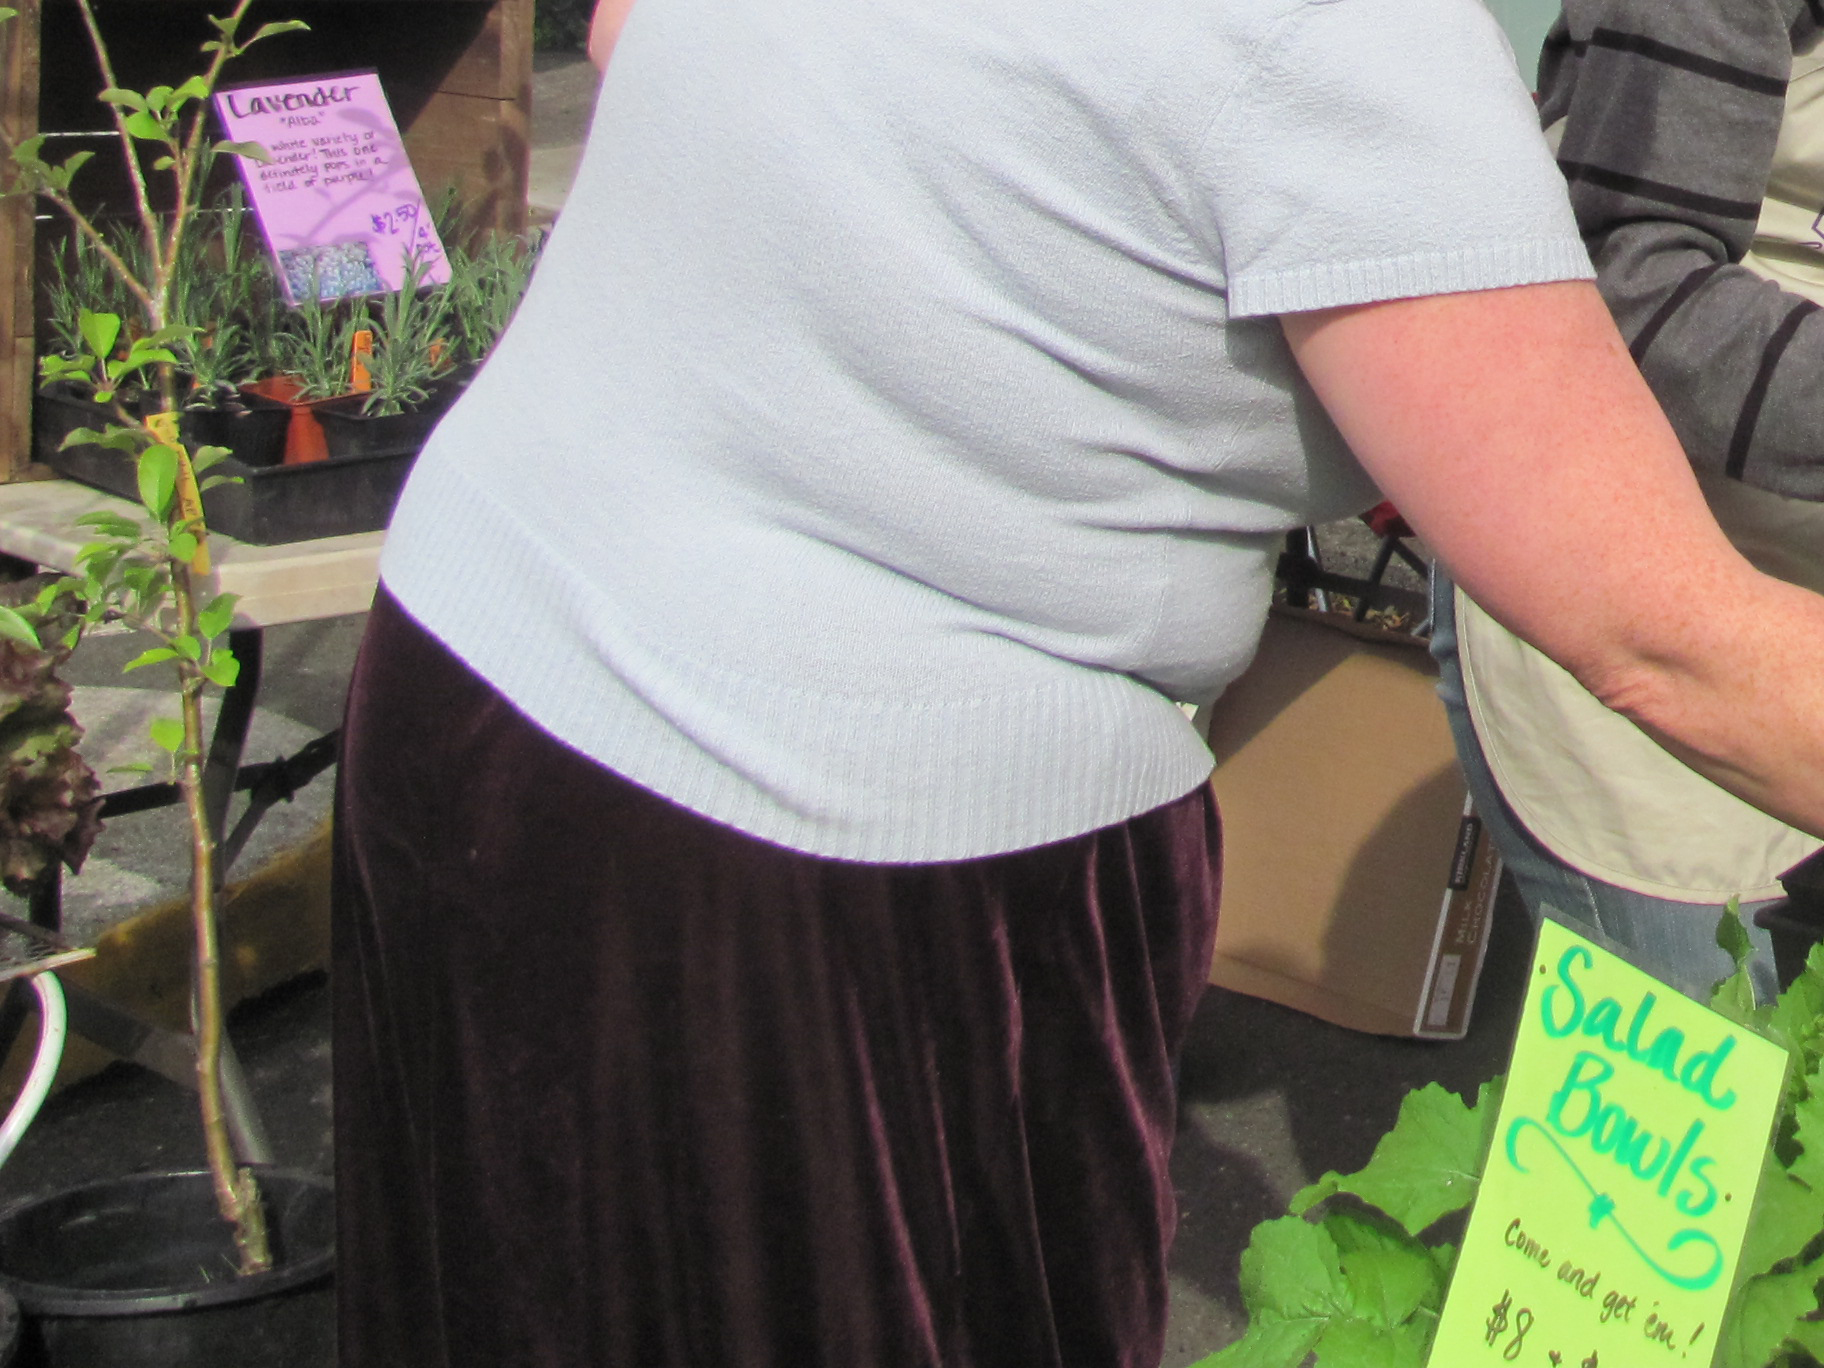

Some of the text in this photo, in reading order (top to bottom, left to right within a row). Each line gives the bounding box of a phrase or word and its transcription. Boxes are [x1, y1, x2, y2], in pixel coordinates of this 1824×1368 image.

[227, 84, 361, 119] Lavender
[1540, 945, 1737, 1111] Salad
[1546, 1051, 1717, 1218] Bowls
[1505, 1217, 1550, 1268] Come
[1557, 1260, 1601, 1299] and
[1600, 1290, 1637, 1323] get
[1485, 1288, 1534, 1361] $8
